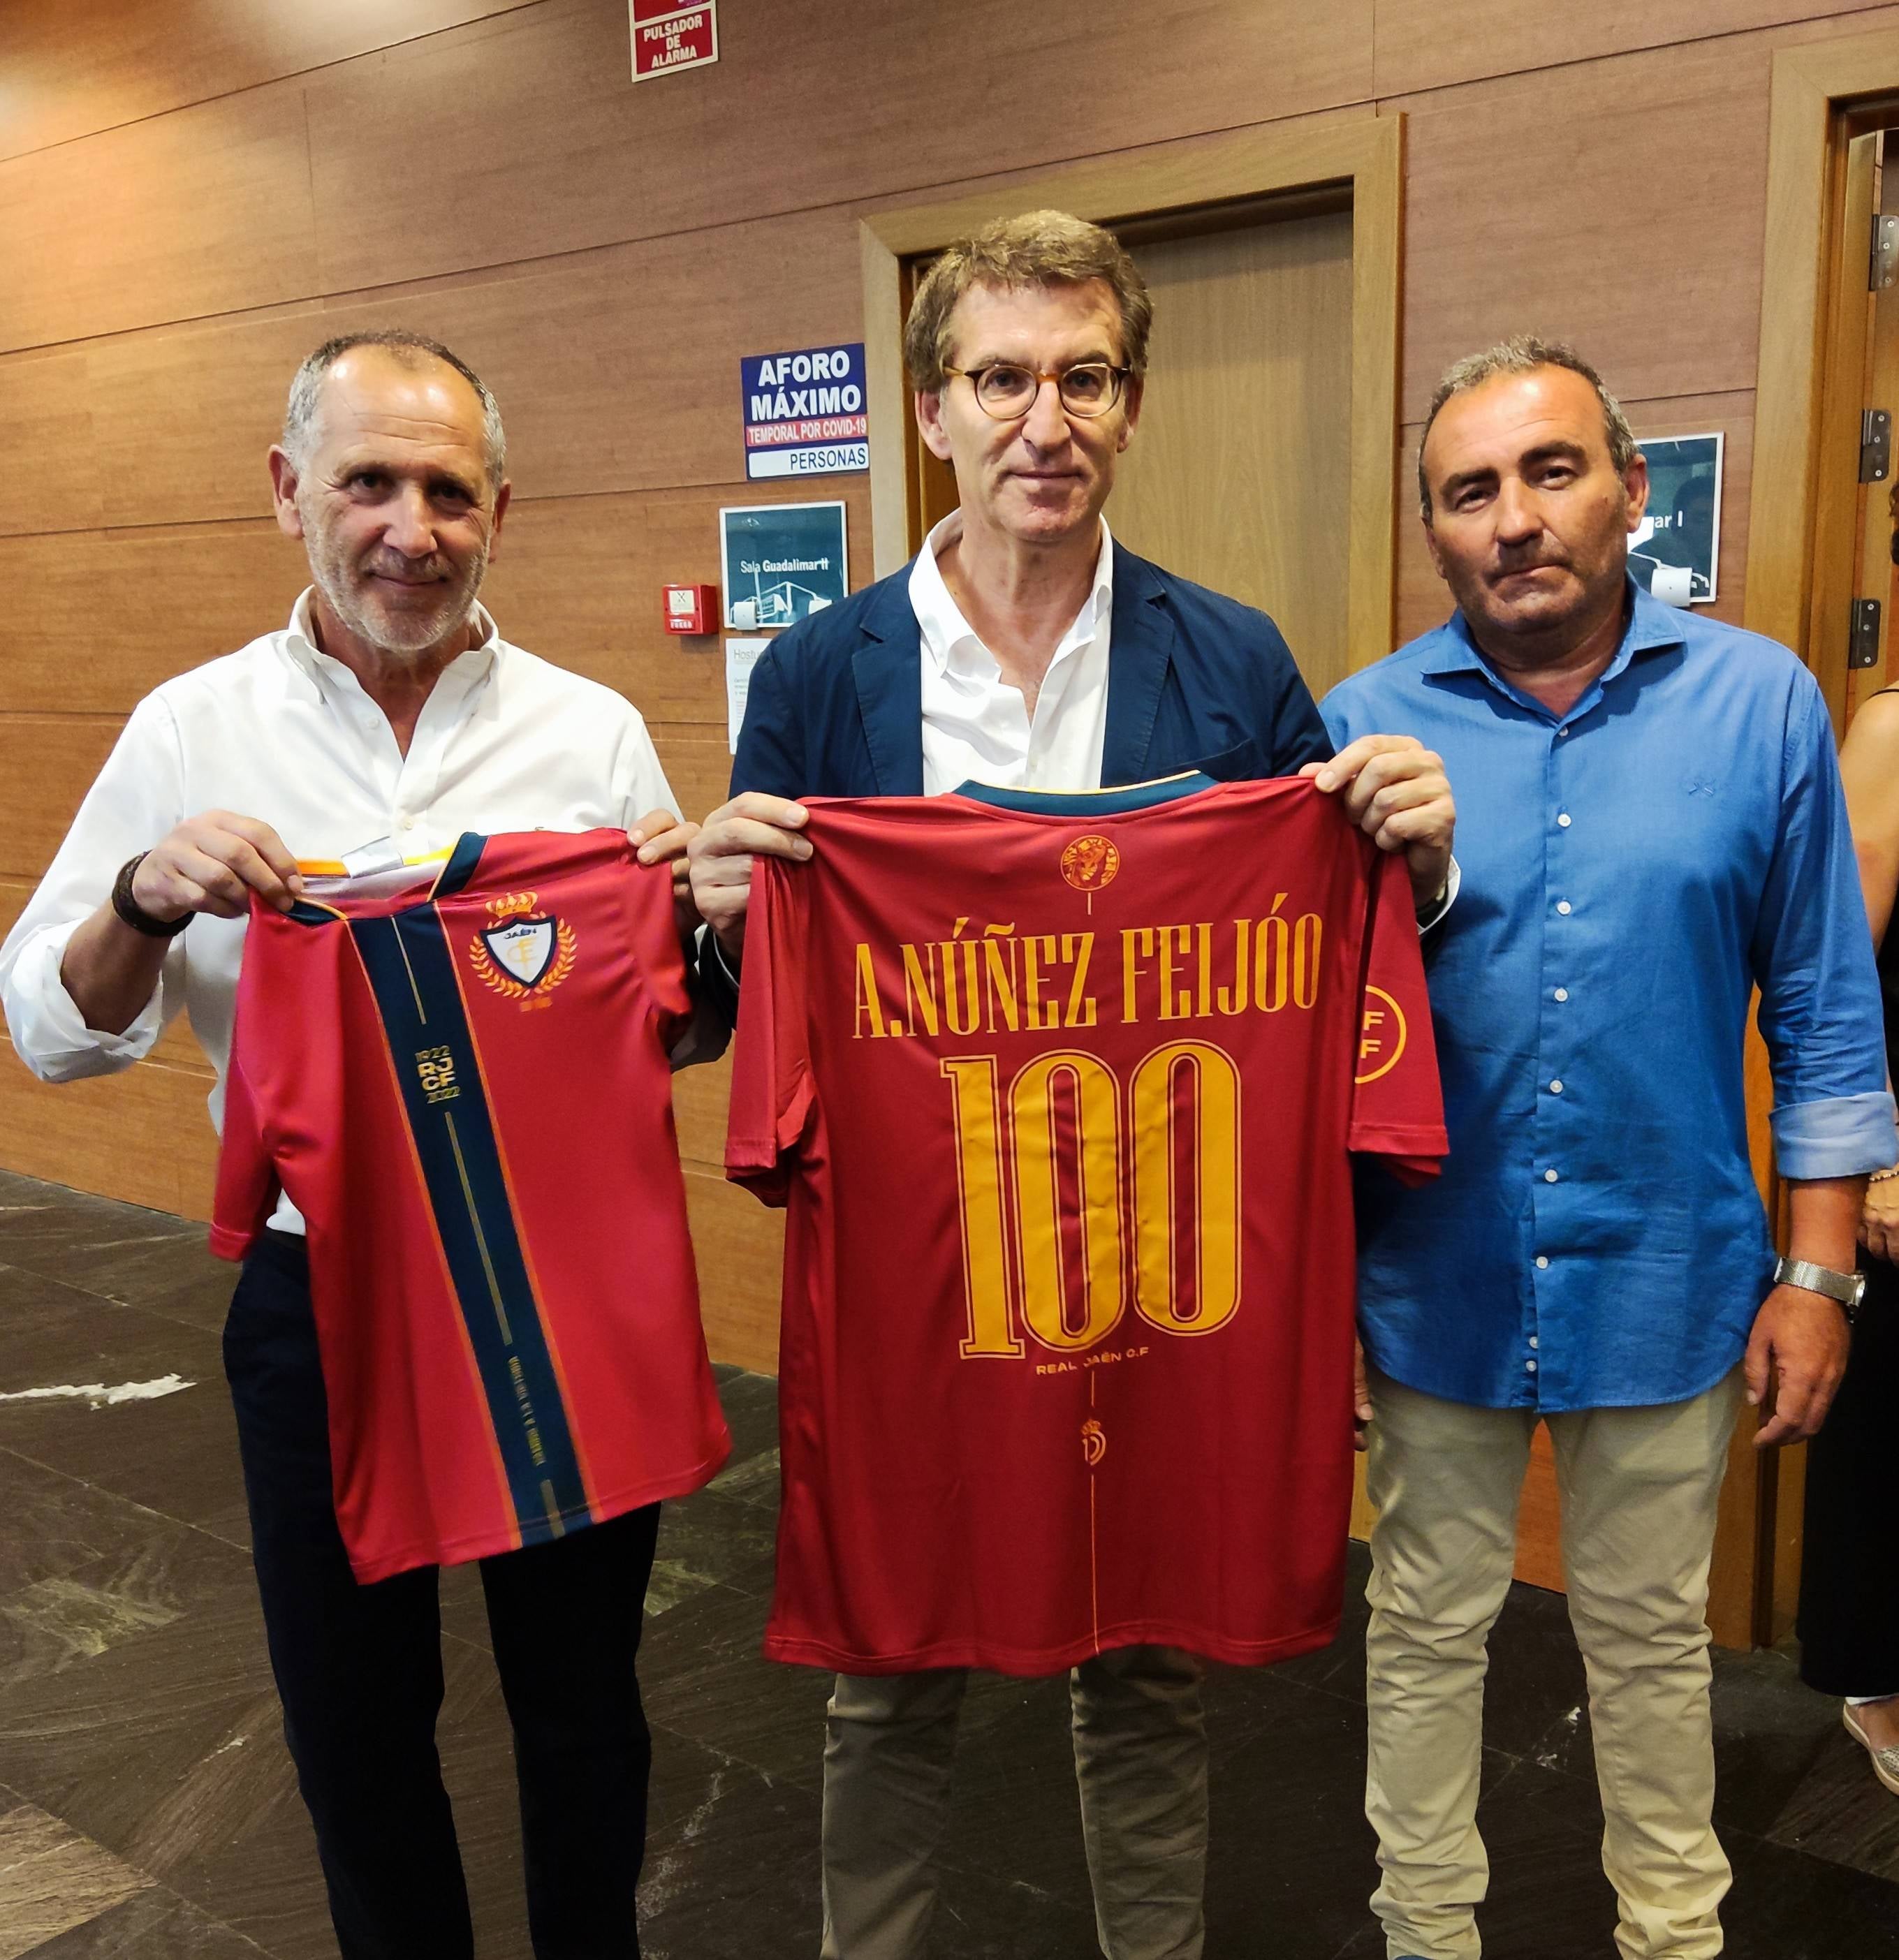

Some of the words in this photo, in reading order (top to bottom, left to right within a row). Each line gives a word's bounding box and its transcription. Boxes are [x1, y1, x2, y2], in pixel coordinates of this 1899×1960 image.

[643, 14, 703, 42] PULSADOR
[666, 35, 681, 50] DE
[651, 45, 698, 68] ALARMA
[758, 350, 850, 386] AFORO
[751, 384, 861, 421] MÁXIMO
[749, 425, 800, 443] TEMPORAL
[800, 422, 821, 439] POR
[823, 418, 867, 436] COVID-19
[790, 448, 866, 470] PERSONAS
[740, 561, 761, 573] Sala
[762, 559, 817, 572] Guadalimar
[852, 916, 1097, 1040] A.NÚÑEZ
[1120, 892, 1323, 1024] FEIJÓO
[939, 1038, 1242, 1360] 100
[1036, 1362, 1078, 1375] REAL
[1083, 1350, 1122, 1368] JAÉN
